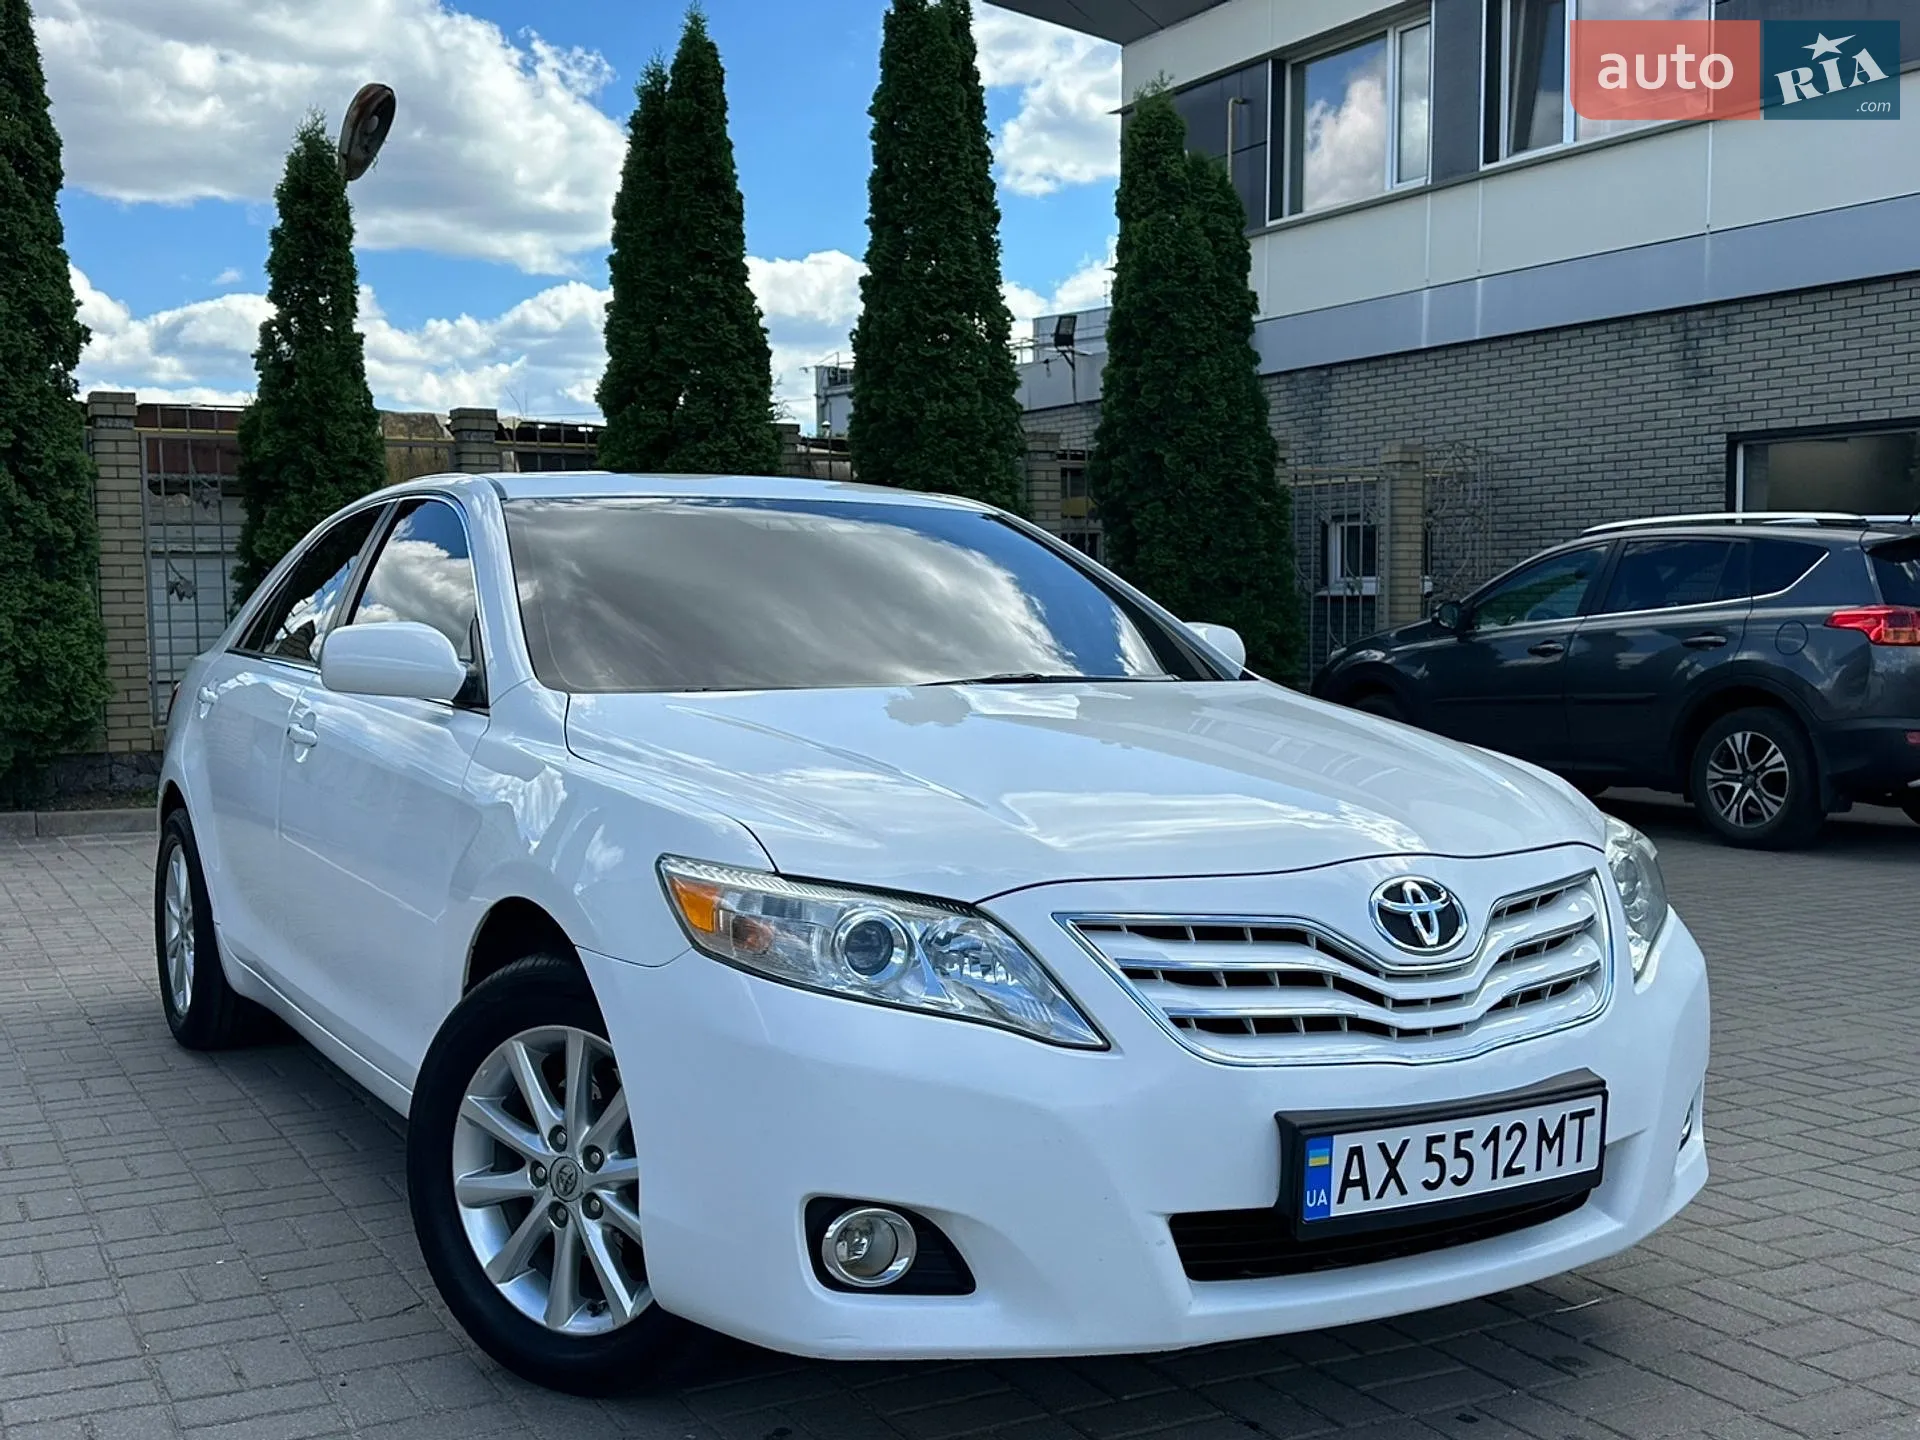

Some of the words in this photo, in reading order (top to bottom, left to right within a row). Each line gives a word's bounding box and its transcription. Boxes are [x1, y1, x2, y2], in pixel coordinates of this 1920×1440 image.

[1336, 1137, 1410, 1205] AX
[1421, 1119, 1527, 1191] 5512
[1535, 1107, 1596, 1173] MT
[1307, 1189, 1328, 1207] UA
